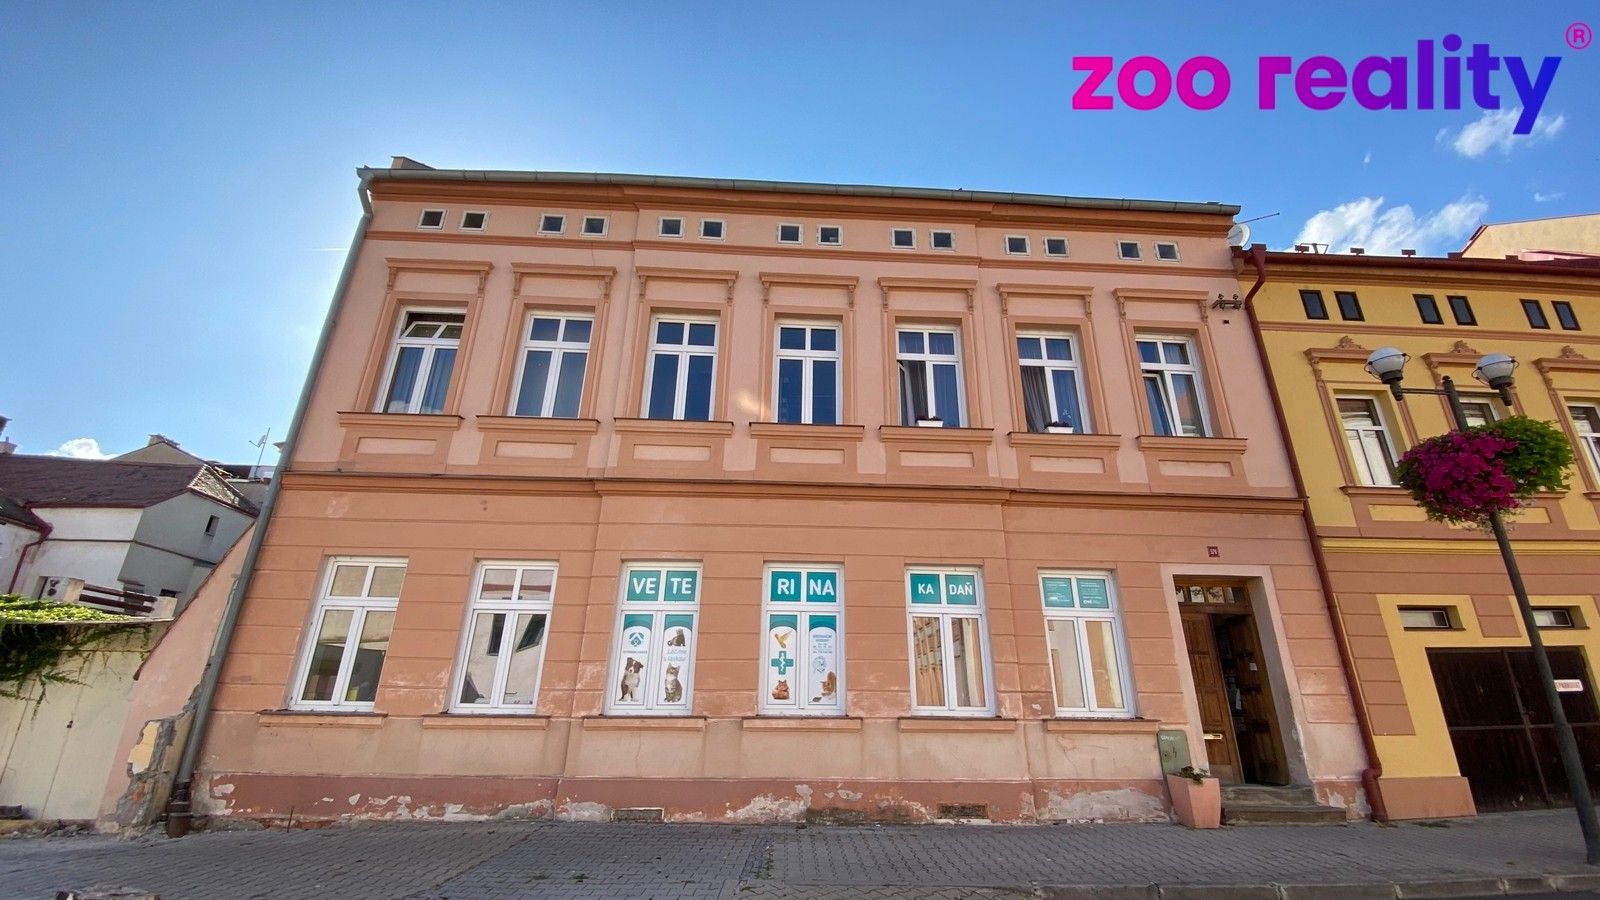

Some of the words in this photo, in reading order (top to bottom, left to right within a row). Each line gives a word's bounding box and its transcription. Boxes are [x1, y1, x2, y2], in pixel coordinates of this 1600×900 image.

[632, 577, 657, 595] VE
[670, 577, 692, 595] TE
[777, 578, 795, 595] RI
[809, 579, 835, 596] NA
[918, 583, 935, 595] KA
[949, 582, 973, 596] DAŇ
